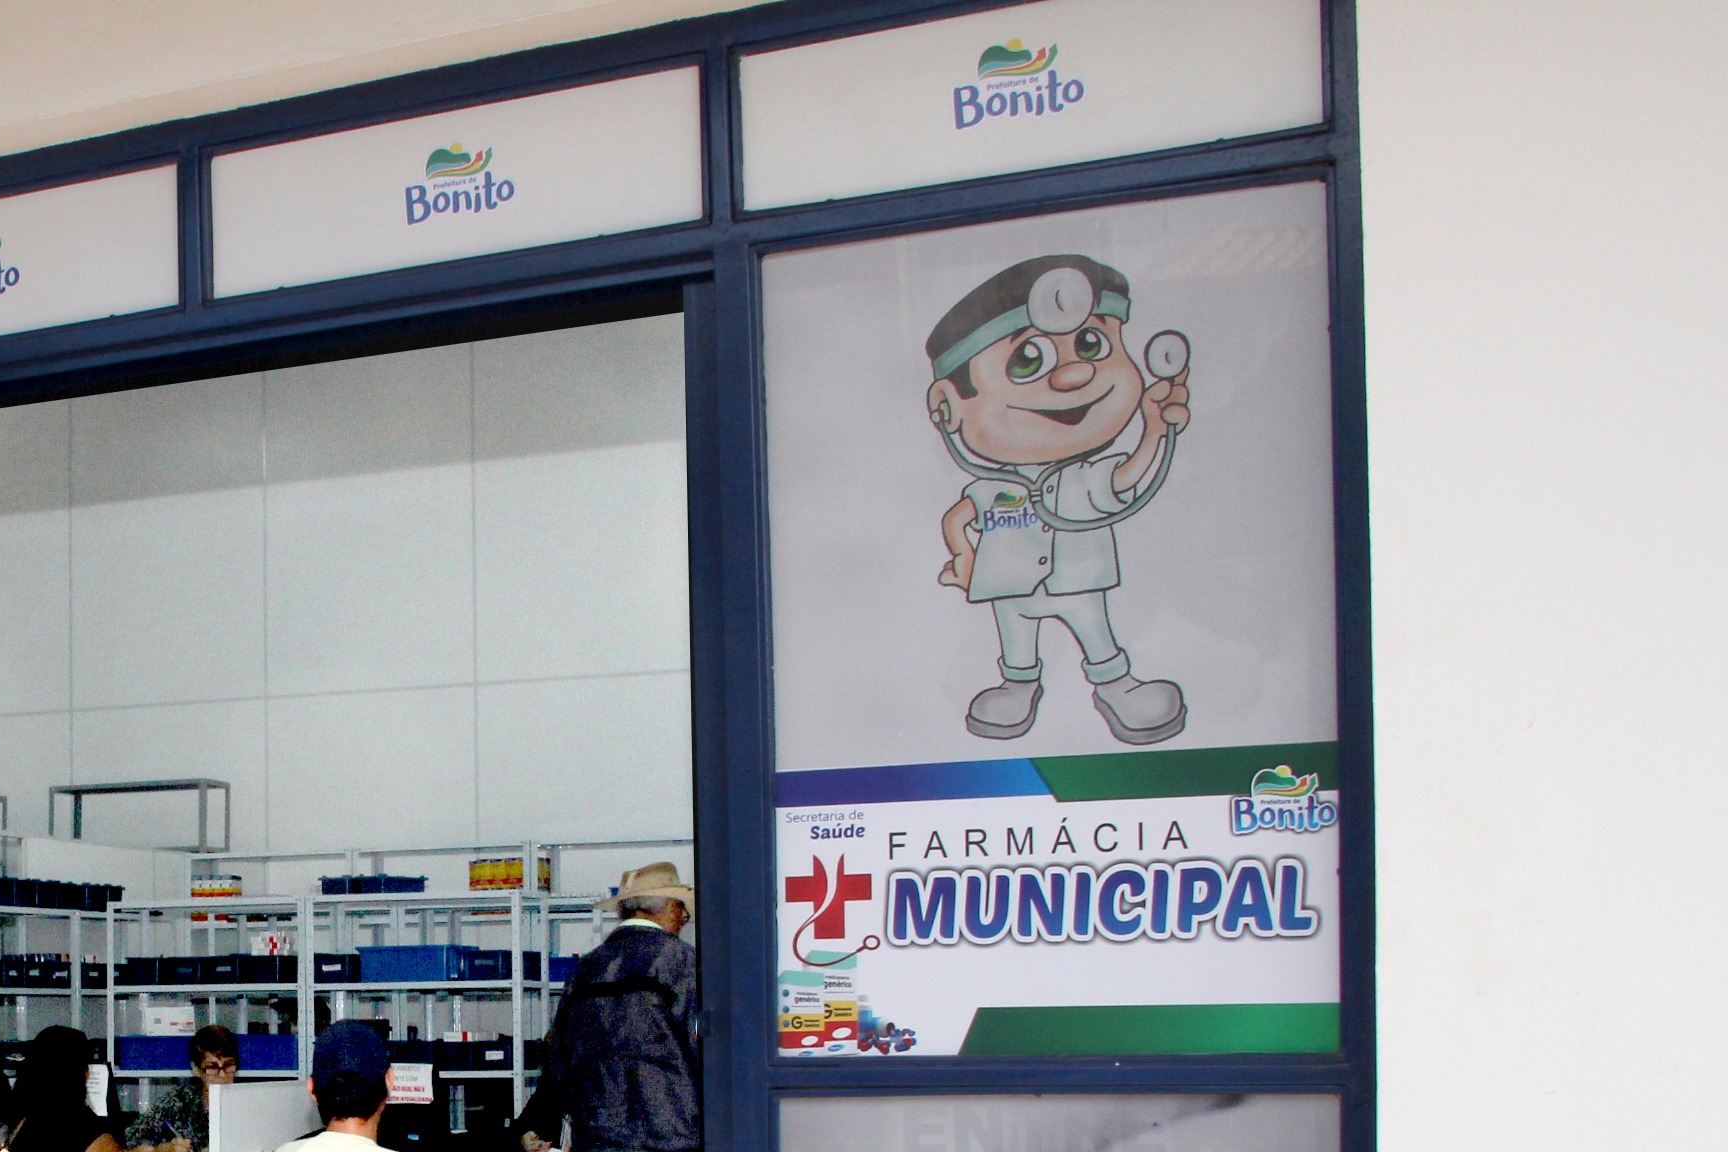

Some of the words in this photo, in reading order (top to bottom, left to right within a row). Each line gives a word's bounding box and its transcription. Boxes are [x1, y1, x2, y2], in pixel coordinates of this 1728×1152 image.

[953, 69, 1084, 130] Bonito
[986, 78, 1027, 91] Prefeitura
[1029, 76, 1039, 84] de
[405, 171, 515, 226] Bonito
[983, 507, 1039, 532] Bonito
[785, 810, 845, 824] Secretaria
[848, 809, 864, 821] de
[1232, 794, 1337, 834] Bonito
[810, 822, 866, 840] Saúde
[888, 816, 1189, 860] FARMÁCIA
[889, 861, 1316, 943] MUNICIPAL
[791, 1015, 803, 1029] G
